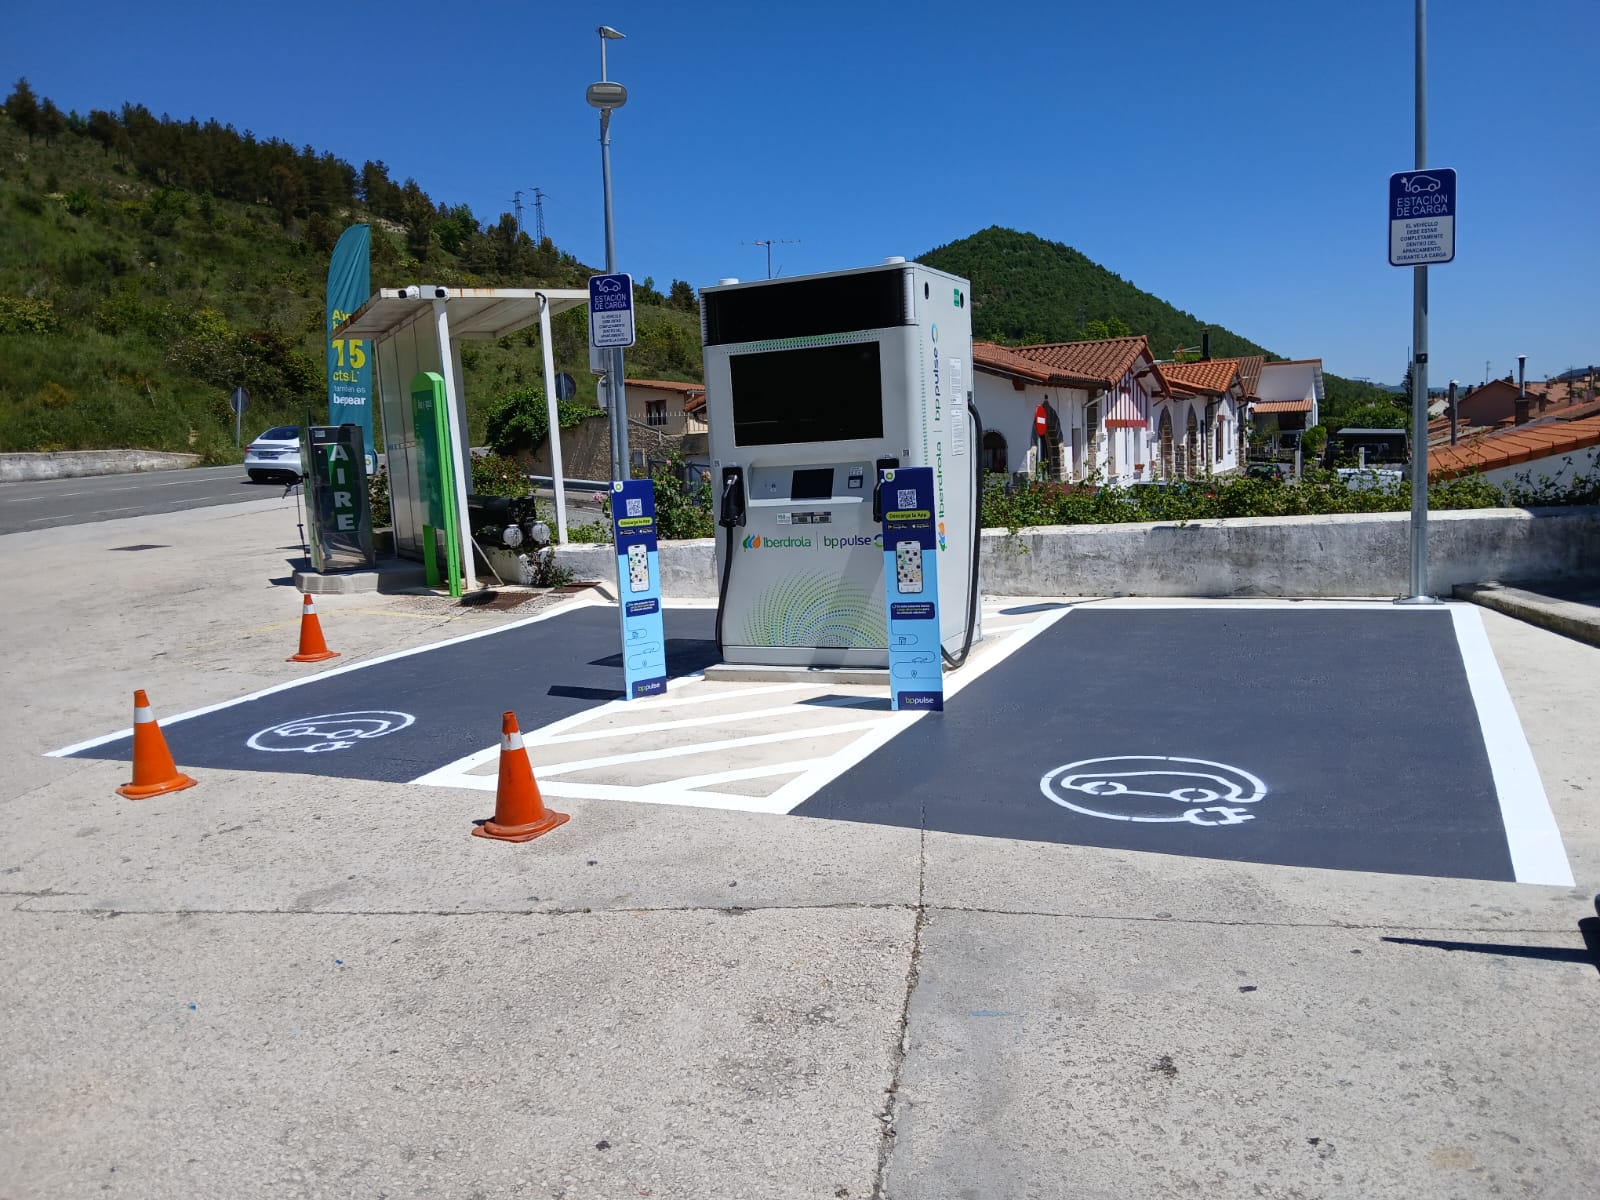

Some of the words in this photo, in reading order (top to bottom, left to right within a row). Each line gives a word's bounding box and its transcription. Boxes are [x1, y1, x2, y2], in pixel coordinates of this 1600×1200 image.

[1397, 193, 1448, 207] ESTACIÓN
[1396, 207, 1410, 217] DE
[1412, 204, 1448, 215] CARGA
[594, 293, 626, 302] ESTACIÓN
[594, 302, 604, 310] DE
[604, 301, 627, 309] CARGA
[331, 338, 366, 369] 15
[936, 441, 944, 518] Iberdrola
[329, 444, 356, 531] AIRE
[763, 536, 812, 548] Iberdrola
